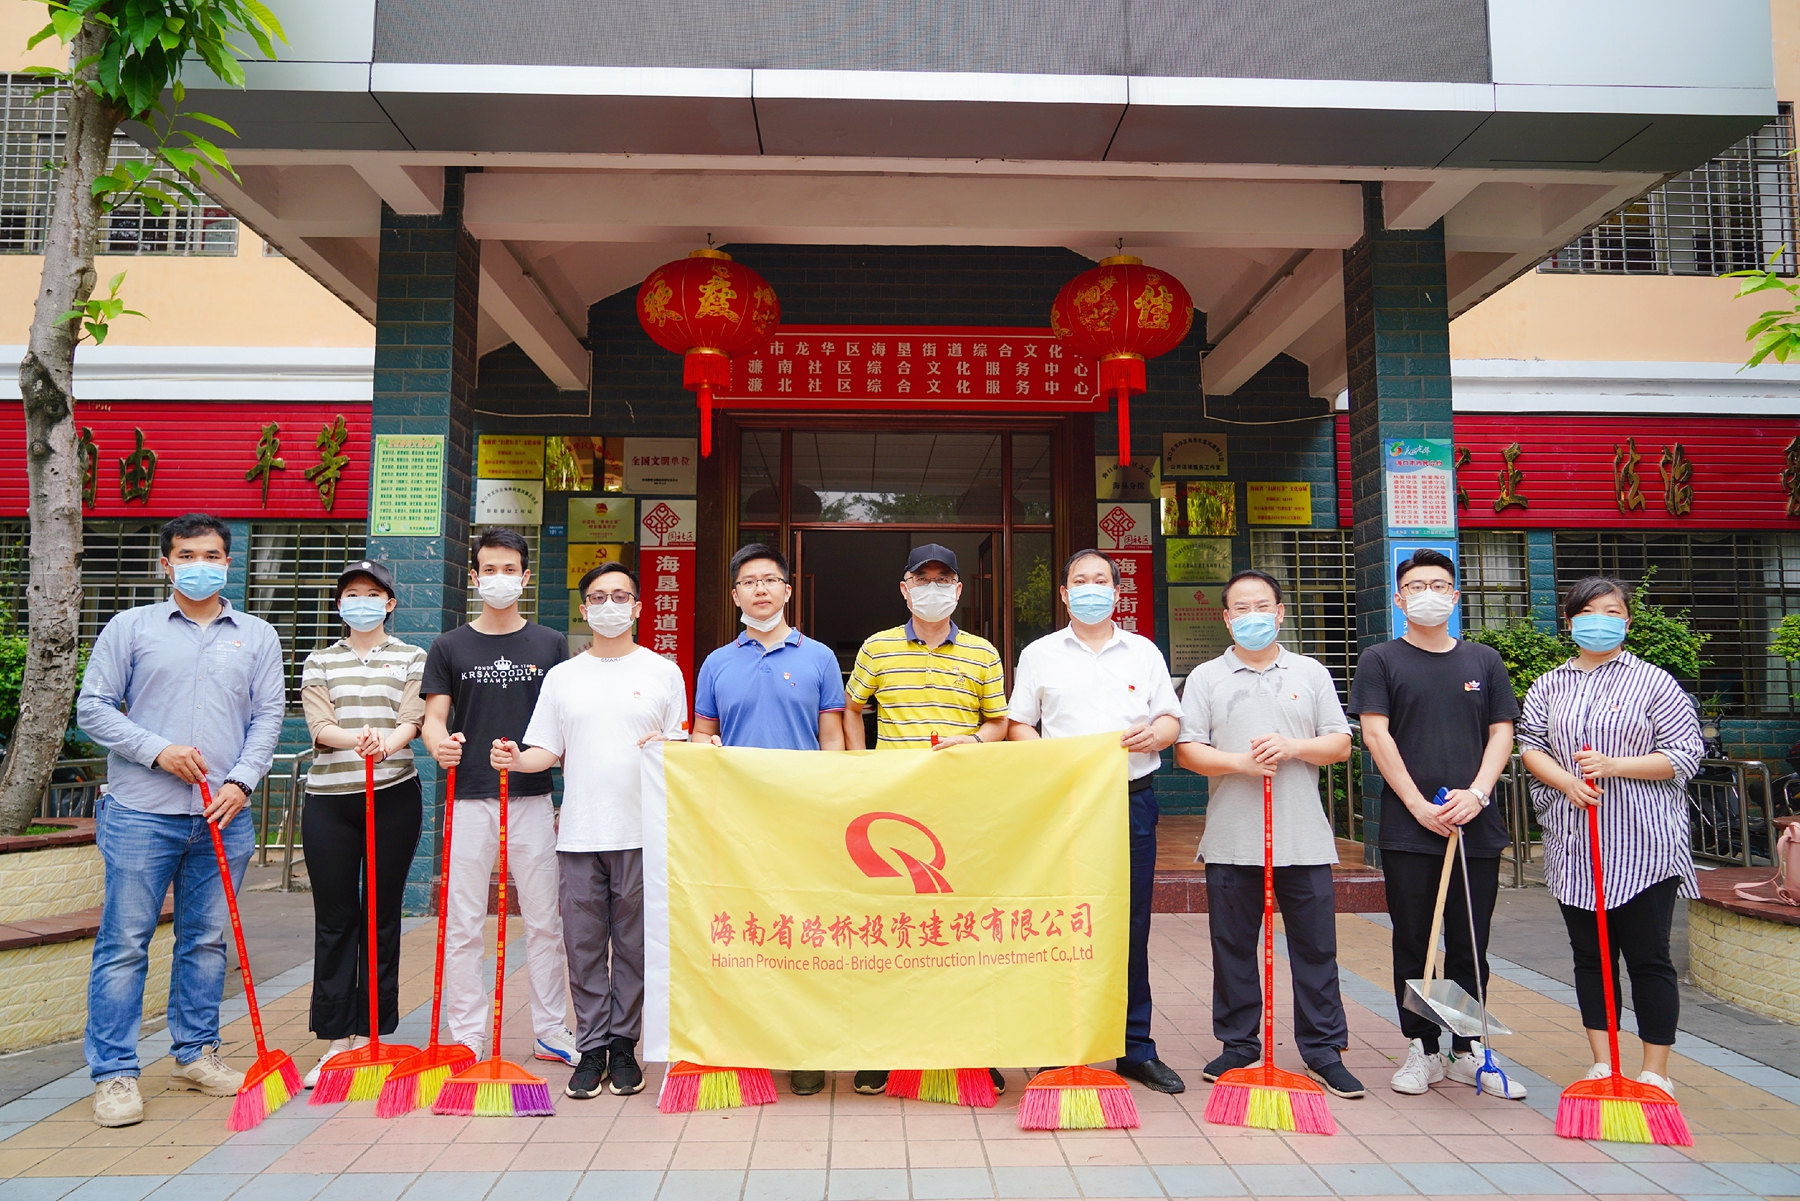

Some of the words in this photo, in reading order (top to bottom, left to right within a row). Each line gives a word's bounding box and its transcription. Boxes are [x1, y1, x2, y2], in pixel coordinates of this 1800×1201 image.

[754, 340, 1084, 358] 市龙华区海垦街道综合文化
[729, 359, 1089, 376] 濂南社区综合文化服务中心
[729, 378, 1089, 394] 濂北社区综合文化服务中心
[632, 456, 690, 466] 全国文明单位
[1102, 462, 1155, 479] 海口市区文化馆
[1116, 558, 1138, 632] 海垦街道
[710, 902, 1093, 950] 海南省路桥投资建设有限公司
[712, 953, 754, 968] Hainan
[756, 954, 810, 970] Province
[894, 952, 976, 968] Construction
[978, 948, 1048, 966] Investment
[1050, 944, 1094, 963] Co.,Ltd
